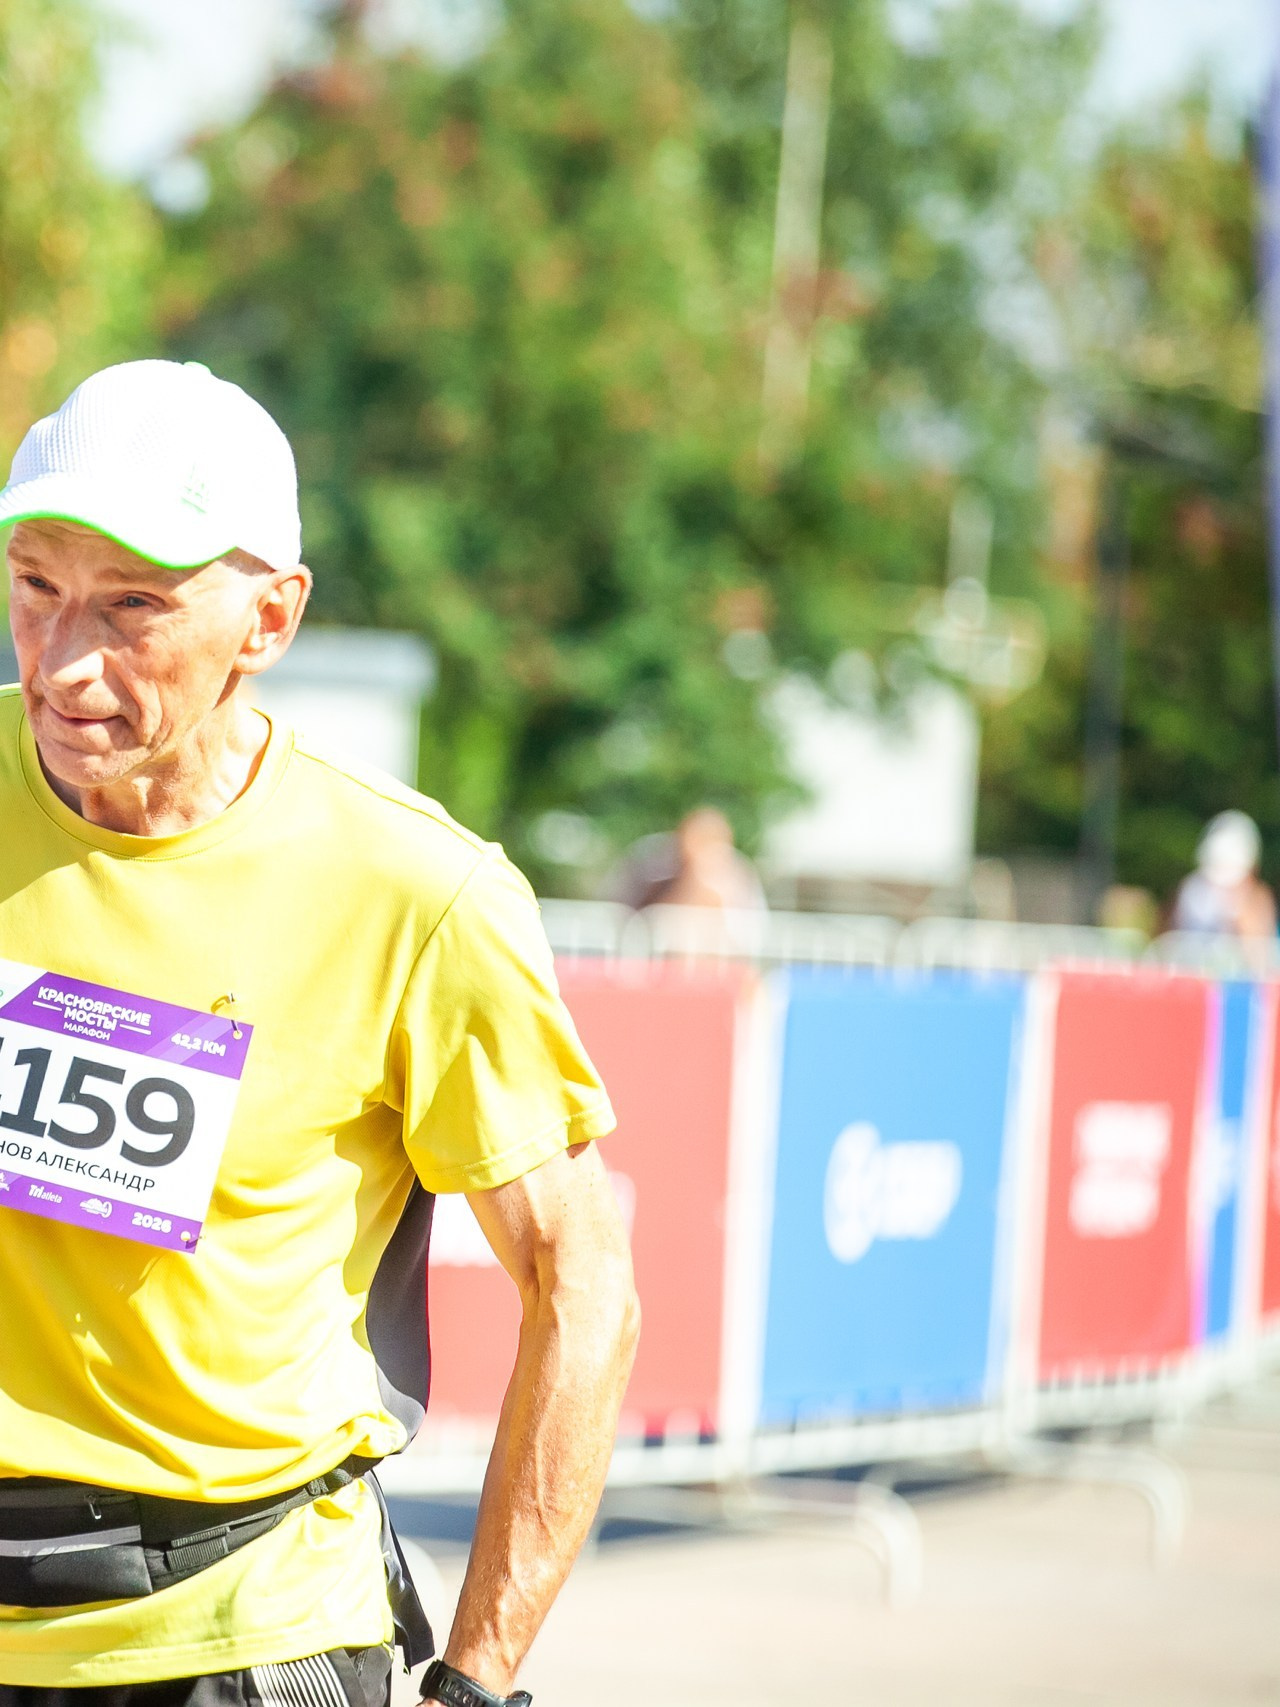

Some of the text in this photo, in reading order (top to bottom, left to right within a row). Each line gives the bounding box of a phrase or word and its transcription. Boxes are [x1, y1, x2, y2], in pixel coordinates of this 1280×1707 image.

[37, 986, 152, 1027] КРАСНОЯРСКИЕ
[63, 1006, 118, 1031] МОСТЫ
[63, 1022, 111, 1041] МАРАФОН
[171, 1032, 227, 1056] 42,2 КМ
[36, 1152, 156, 1193] АЛЕКСАНДР
[131, 1212, 173, 1234] 2026
